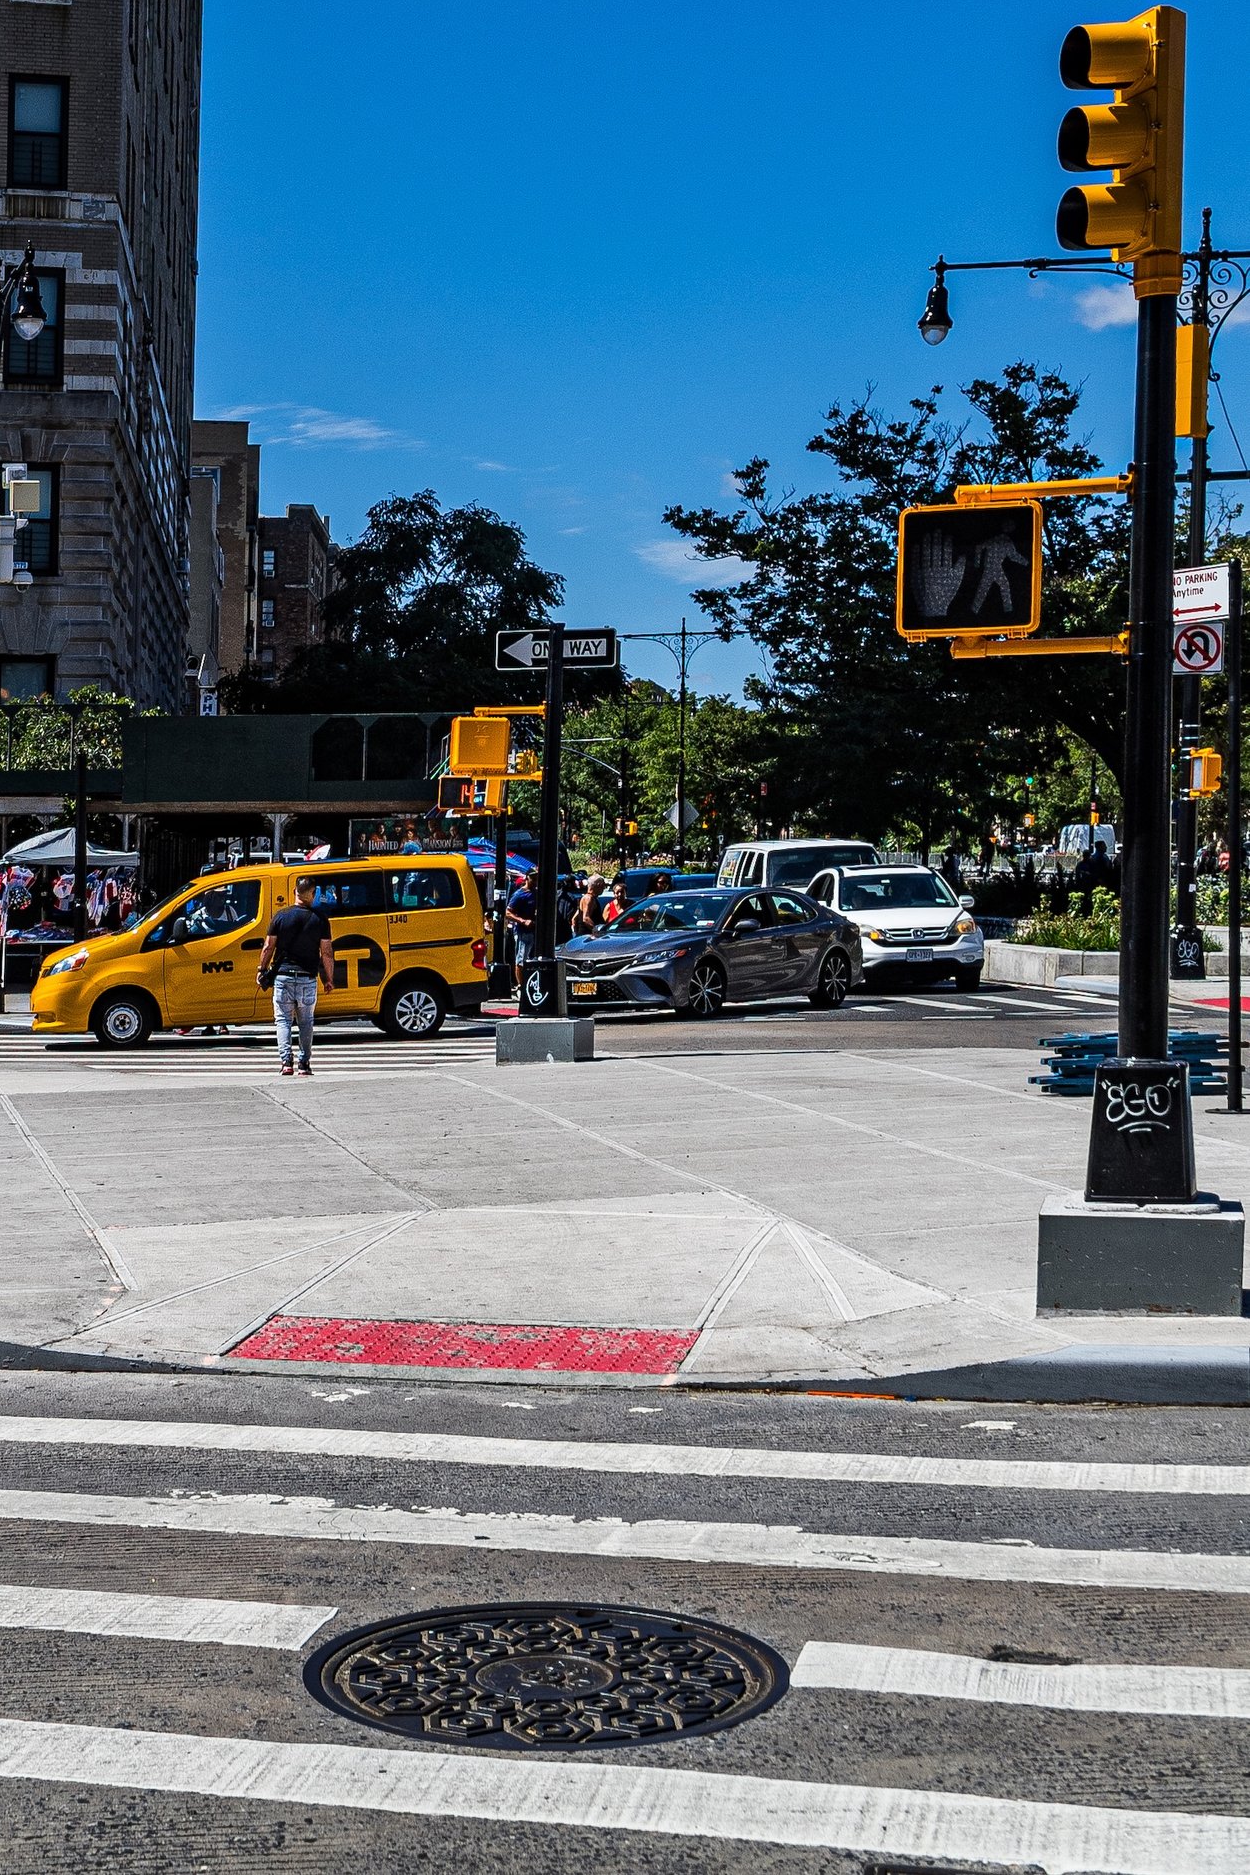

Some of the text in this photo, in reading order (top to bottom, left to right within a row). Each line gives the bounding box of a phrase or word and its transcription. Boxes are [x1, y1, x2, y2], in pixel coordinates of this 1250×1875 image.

[1184, 571, 1218, 585] PARKING
[569, 640, 602, 656] WAY
[368, 840, 398, 851] HAUNTED
[202, 961, 233, 974] NYC
[334, 948, 371, 988] T
